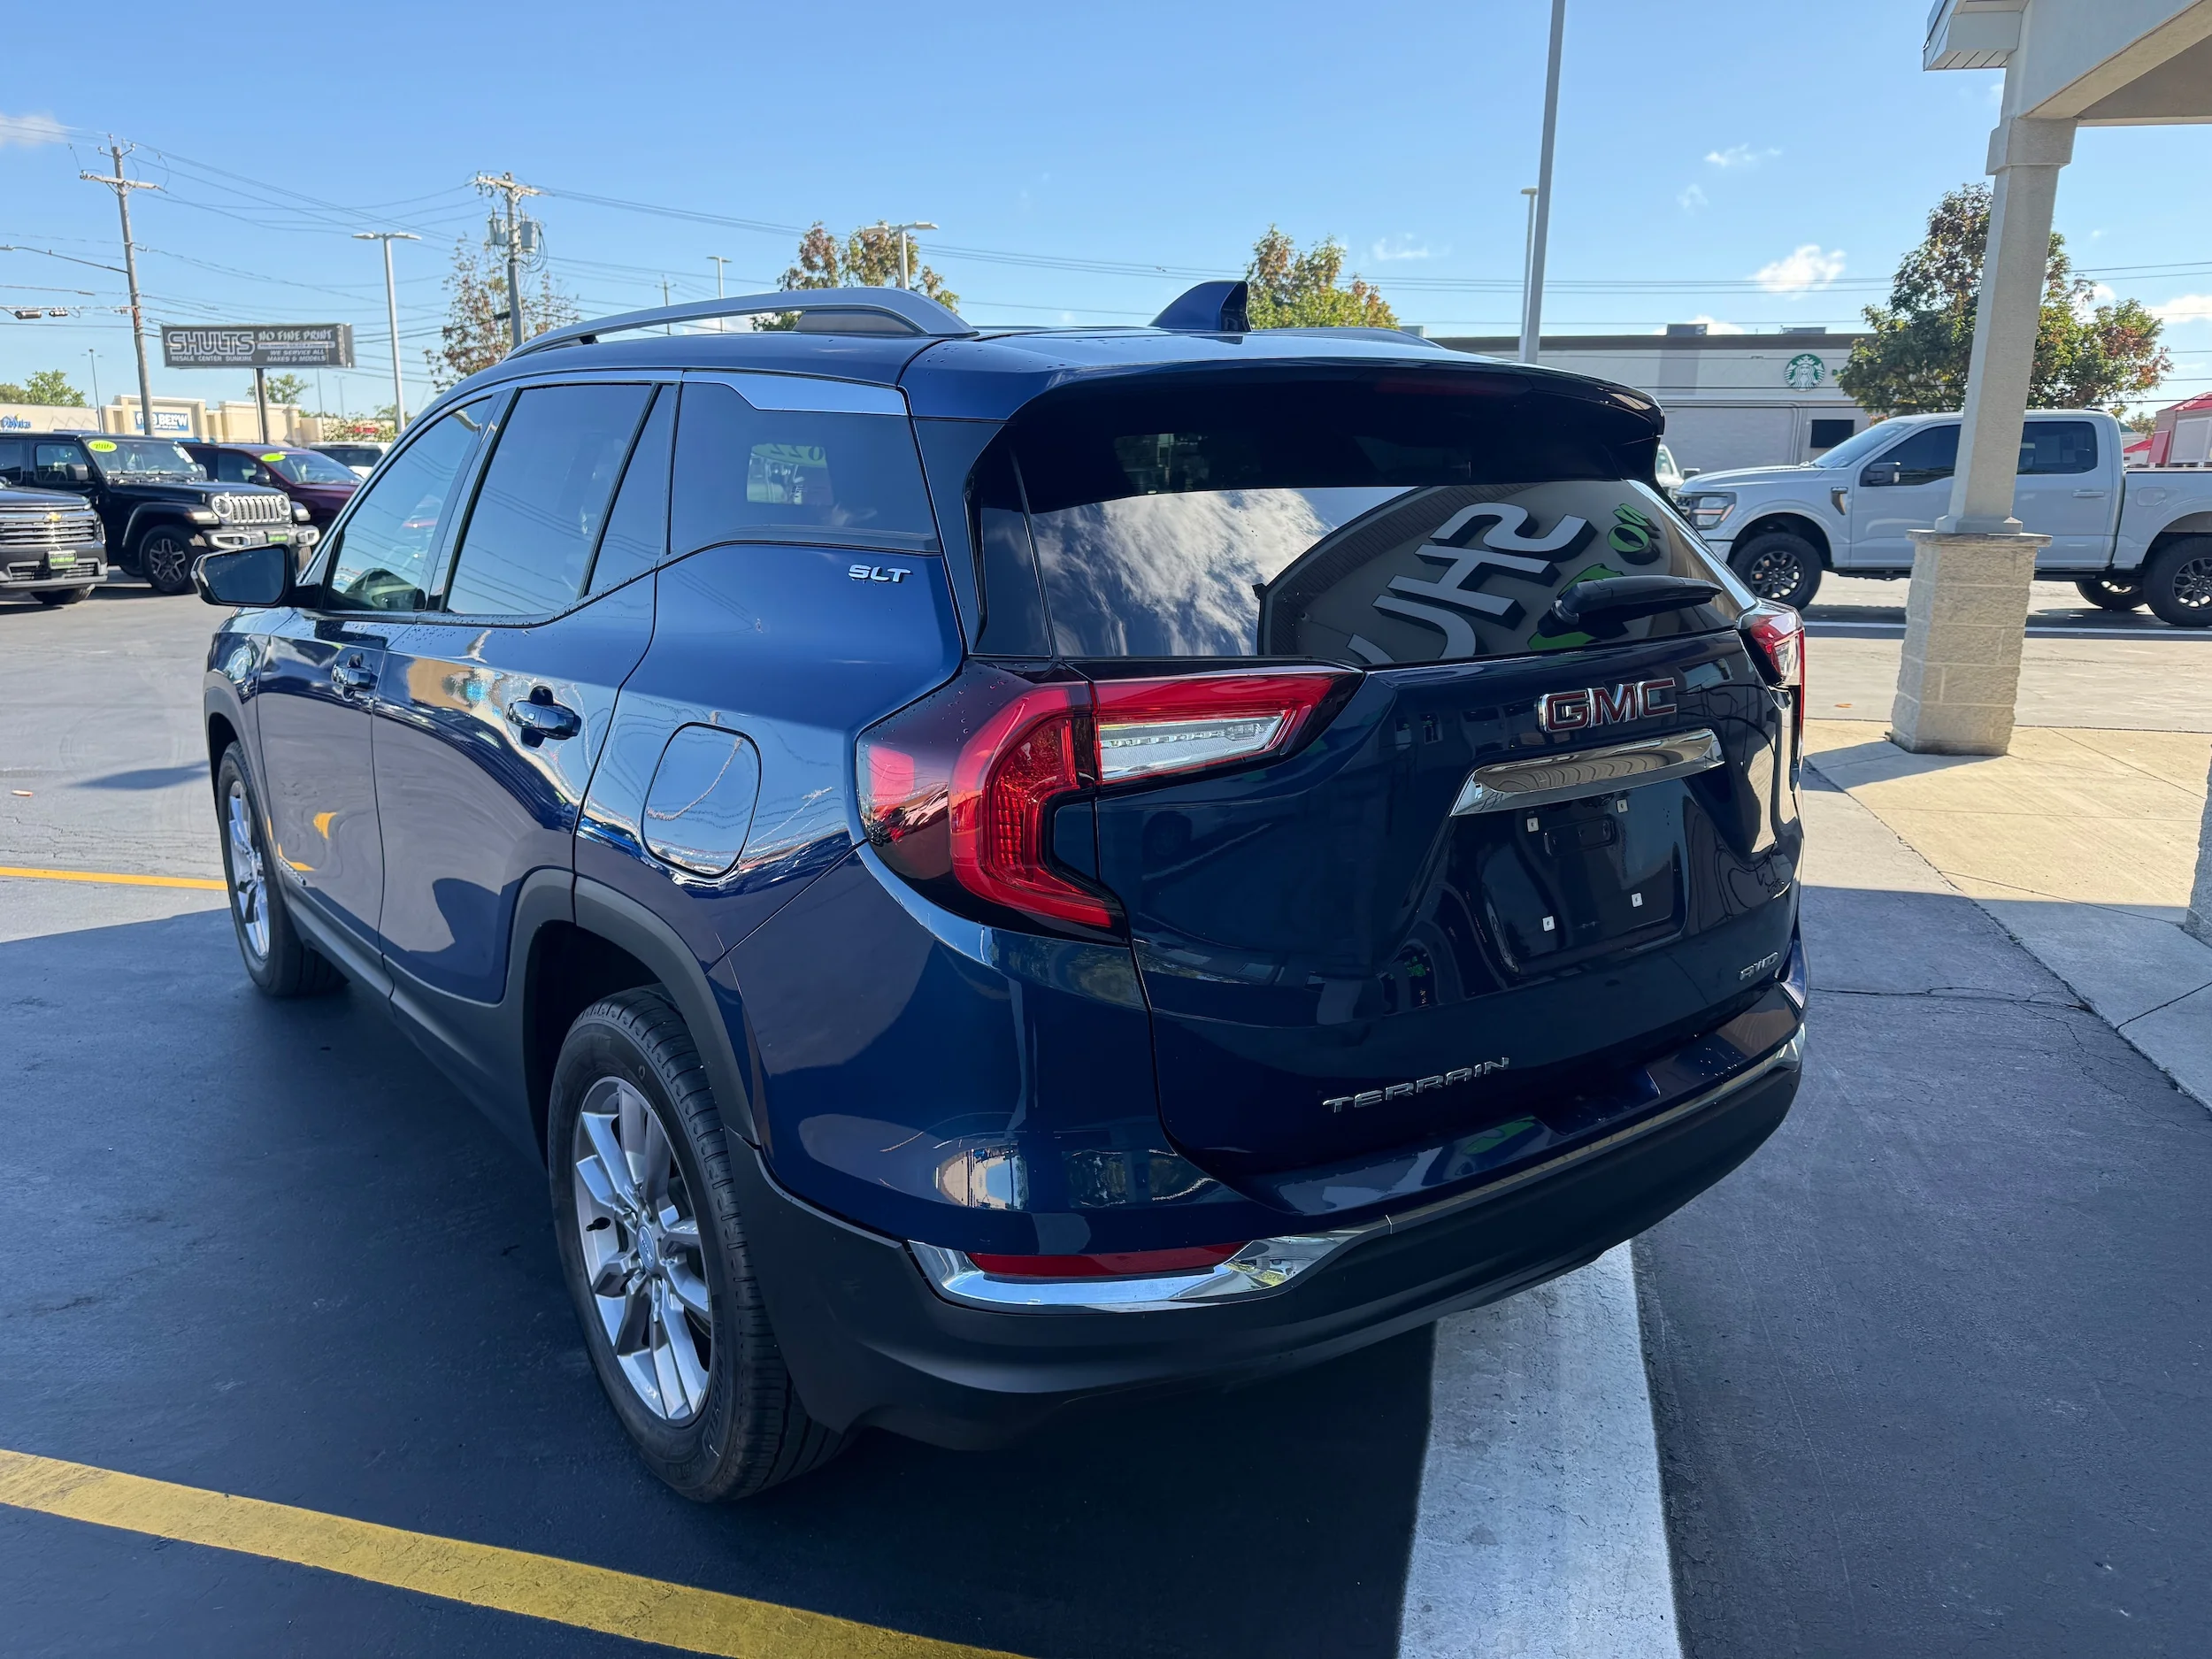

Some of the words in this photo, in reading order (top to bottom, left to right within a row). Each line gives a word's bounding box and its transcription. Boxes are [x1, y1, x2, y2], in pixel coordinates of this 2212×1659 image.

[167, 331, 256, 356] SHULTS
[257, 330, 275, 342] NO
[277, 330, 301, 342] FINE
[303, 329, 333, 341] PRINT
[849, 564, 912, 583] SLT
[1538, 677, 1678, 733] GMC
[1322, 1056, 1509, 1113] TERRAIN
